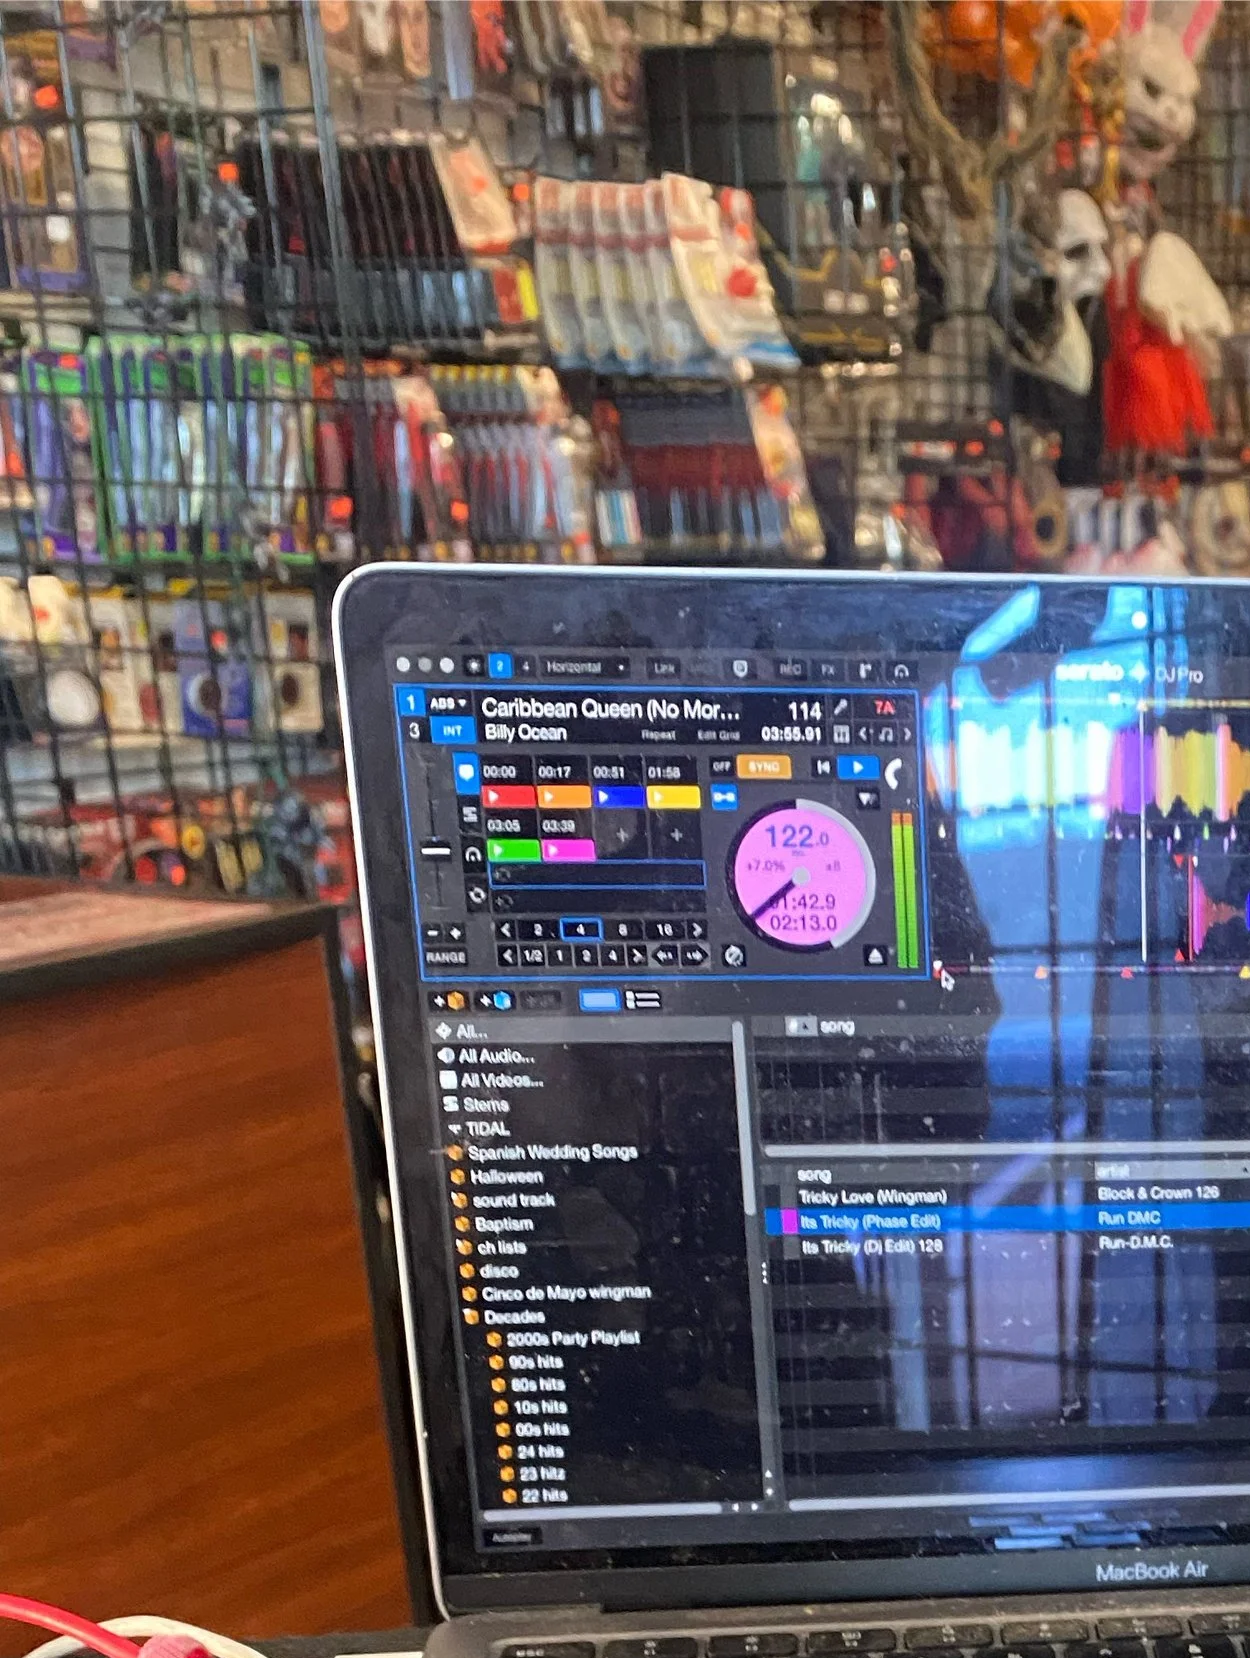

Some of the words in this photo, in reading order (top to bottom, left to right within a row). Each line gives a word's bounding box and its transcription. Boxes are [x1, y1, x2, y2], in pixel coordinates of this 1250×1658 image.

[1055, 664, 1124, 682] serato
[1178, 669, 1203, 683] Pro
[482, 697, 577, 718] Caribbean
[582, 699, 642, 719] Queen
[647, 698, 679, 721] (No
[684, 700, 740, 719] Mor...
[789, 702, 822, 720] 114
[875, 700, 895, 715] 7A
[485, 724, 515, 743] Billy
[519, 724, 567, 740] Ocean
[539, 766, 571, 778] 00:17
[766, 825, 829, 847] 122.0
[770, 916, 837, 931] 02:13.0
[820, 1020, 854, 1036] song
[459, 1050, 477, 1062] All
[462, 1074, 479, 1088] All
[463, 1098, 509, 1113] Stems
[466, 1123, 510, 1136] TIDAL
[469, 1146, 525, 1162] Spanish
[530, 1145, 590, 1162] Wedding
[593, 1144, 638, 1162] Songs
[471, 1170, 543, 1184] Halloween
[798, 1169, 832, 1184] song
[473, 1195, 516, 1208] sound
[520, 1194, 555, 1207] track
[799, 1190, 838, 1206] Tricky
[842, 1190, 874, 1204] Love
[877, 1189, 947, 1205] (Wingman)
[1098, 1188, 1134, 1200] Block
[1151, 1187, 1192, 1199] Crown
[801, 1215, 817, 1229] Its
[820, 1214, 859, 1231] Tricky
[863, 1214, 908, 1229] (Phase
[911, 1214, 940, 1229] Edit)
[1099, 1211, 1124, 1224] Run
[1128, 1210, 1160, 1223] DMC
[475, 1217, 534, 1234] Baptism
[478, 1243, 496, 1255] ch
[499, 1243, 527, 1255] lists
[802, 1240, 819, 1254] Its
[822, 1240, 860, 1256] Tricky
[886, 1238, 914, 1254] Edit)
[1100, 1235, 1173, 1248] Run-D.M.C.
[480, 1265, 519, 1278] disco
[482, 1288, 523, 1301] Cinco
[526, 1287, 544, 1300] de
[547, 1287, 586, 1302] Mayo
[589, 1287, 651, 1301] wingman
[485, 1311, 545, 1325] Decades
[507, 1333, 549, 1347] 2000s
[552, 1332, 587, 1347] Party
[591, 1331, 640, 1346] Playlist
[538, 1354, 564, 1368] hits
[514, 1402, 538, 1414] 10s
[542, 1400, 567, 1414] hits
[1097, 1560, 1180, 1582] MacBook
[1186, 1561, 1208, 1578] Air
